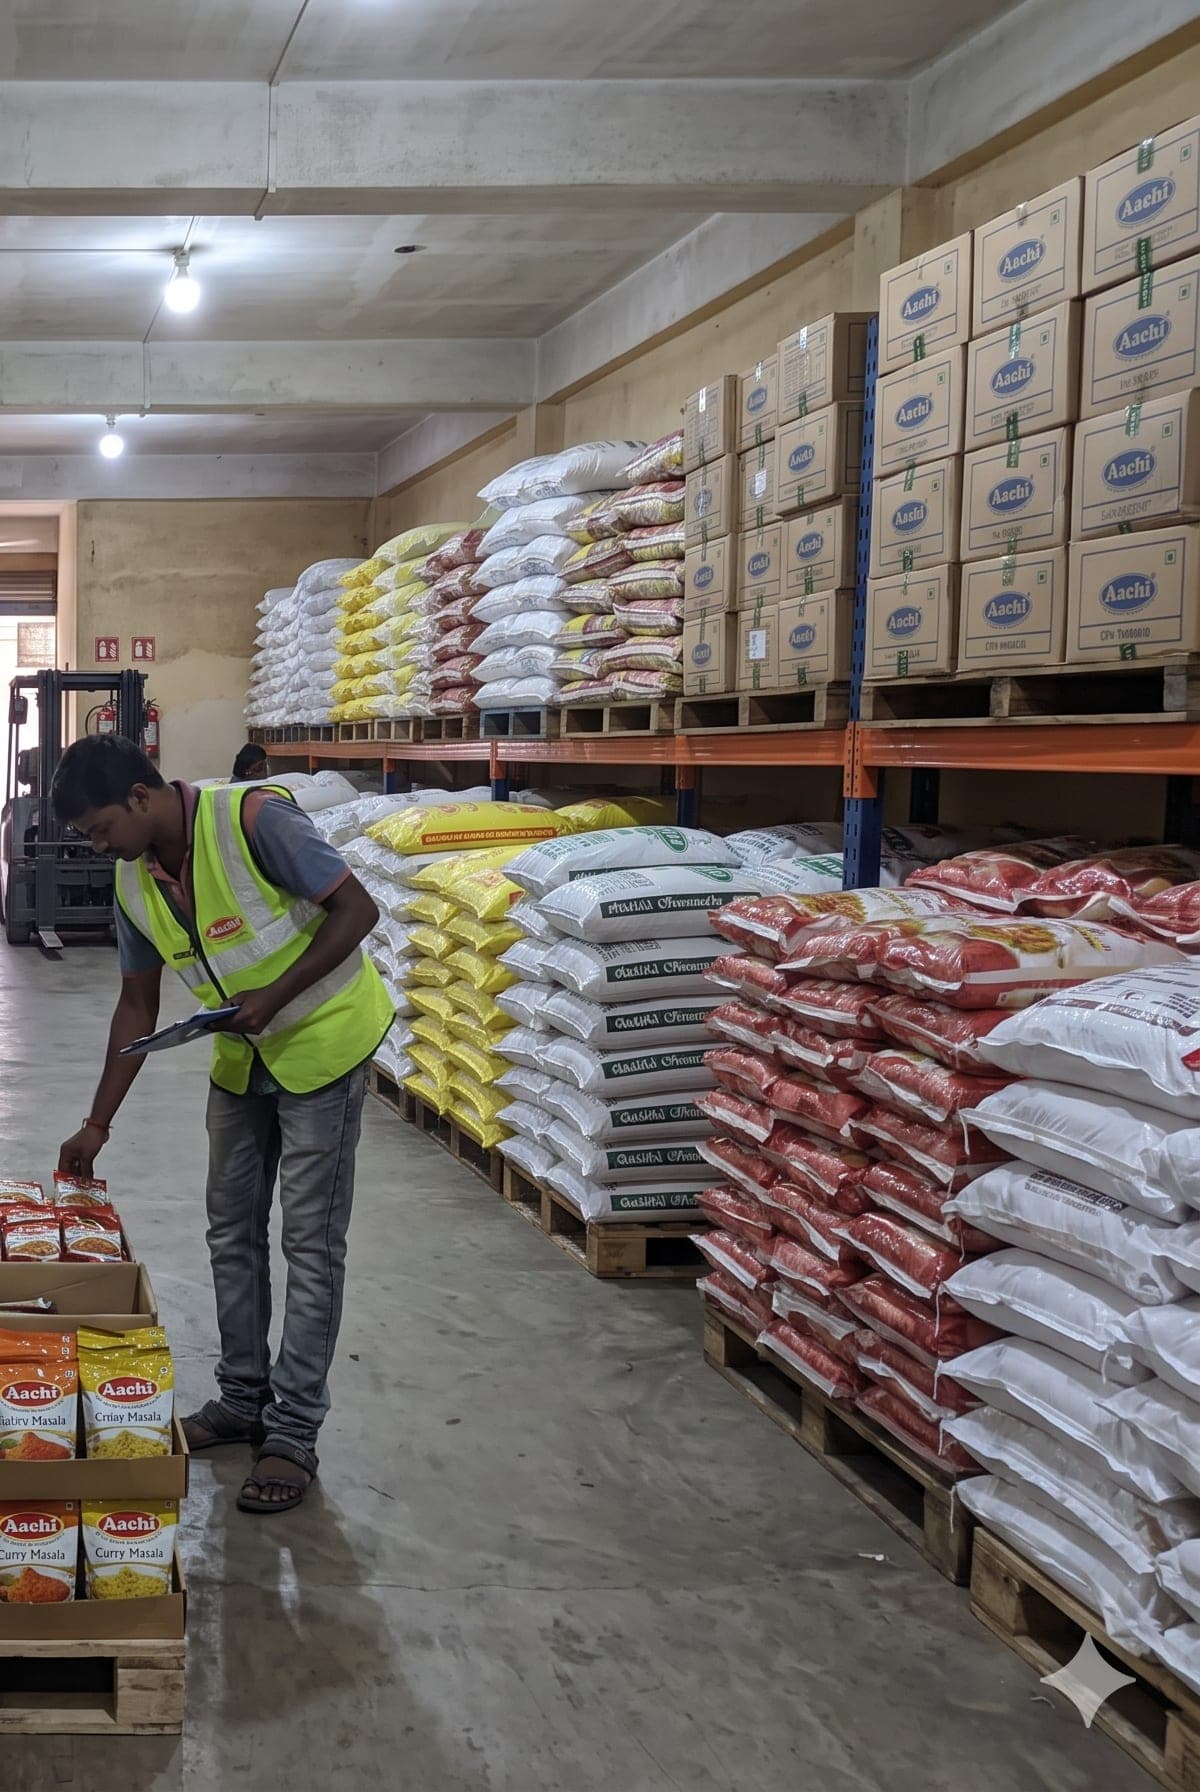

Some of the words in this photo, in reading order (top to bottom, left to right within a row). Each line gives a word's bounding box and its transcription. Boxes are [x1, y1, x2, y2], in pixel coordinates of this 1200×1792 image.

[1119, 182, 1170, 221] Aachi
[1003, 243, 1042, 274] Aachi
[1117, 319, 1166, 352] Aachi
[993, 361, 1032, 391] Aachi
[1107, 453, 1151, 480] Aachi
[991, 480, 1031, 504] Aachi
[1103, 577, 1151, 603] Aachi
[986, 594, 1028, 617] Aachi
[5, 1385, 59, 1401] Aachi
[102, 1381, 154, 1397] Aachi
[32, 1414, 67, 1426] Masala
[127, 1411, 162, 1422] Masala
[3, 1517, 58, 1534] Aachi
[103, 1516, 156, 1532] Aachi
[31, 1549, 66, 1561] Masala
[95, 1547, 126, 1561] Curry
[128, 1547, 165, 1559] Masala
